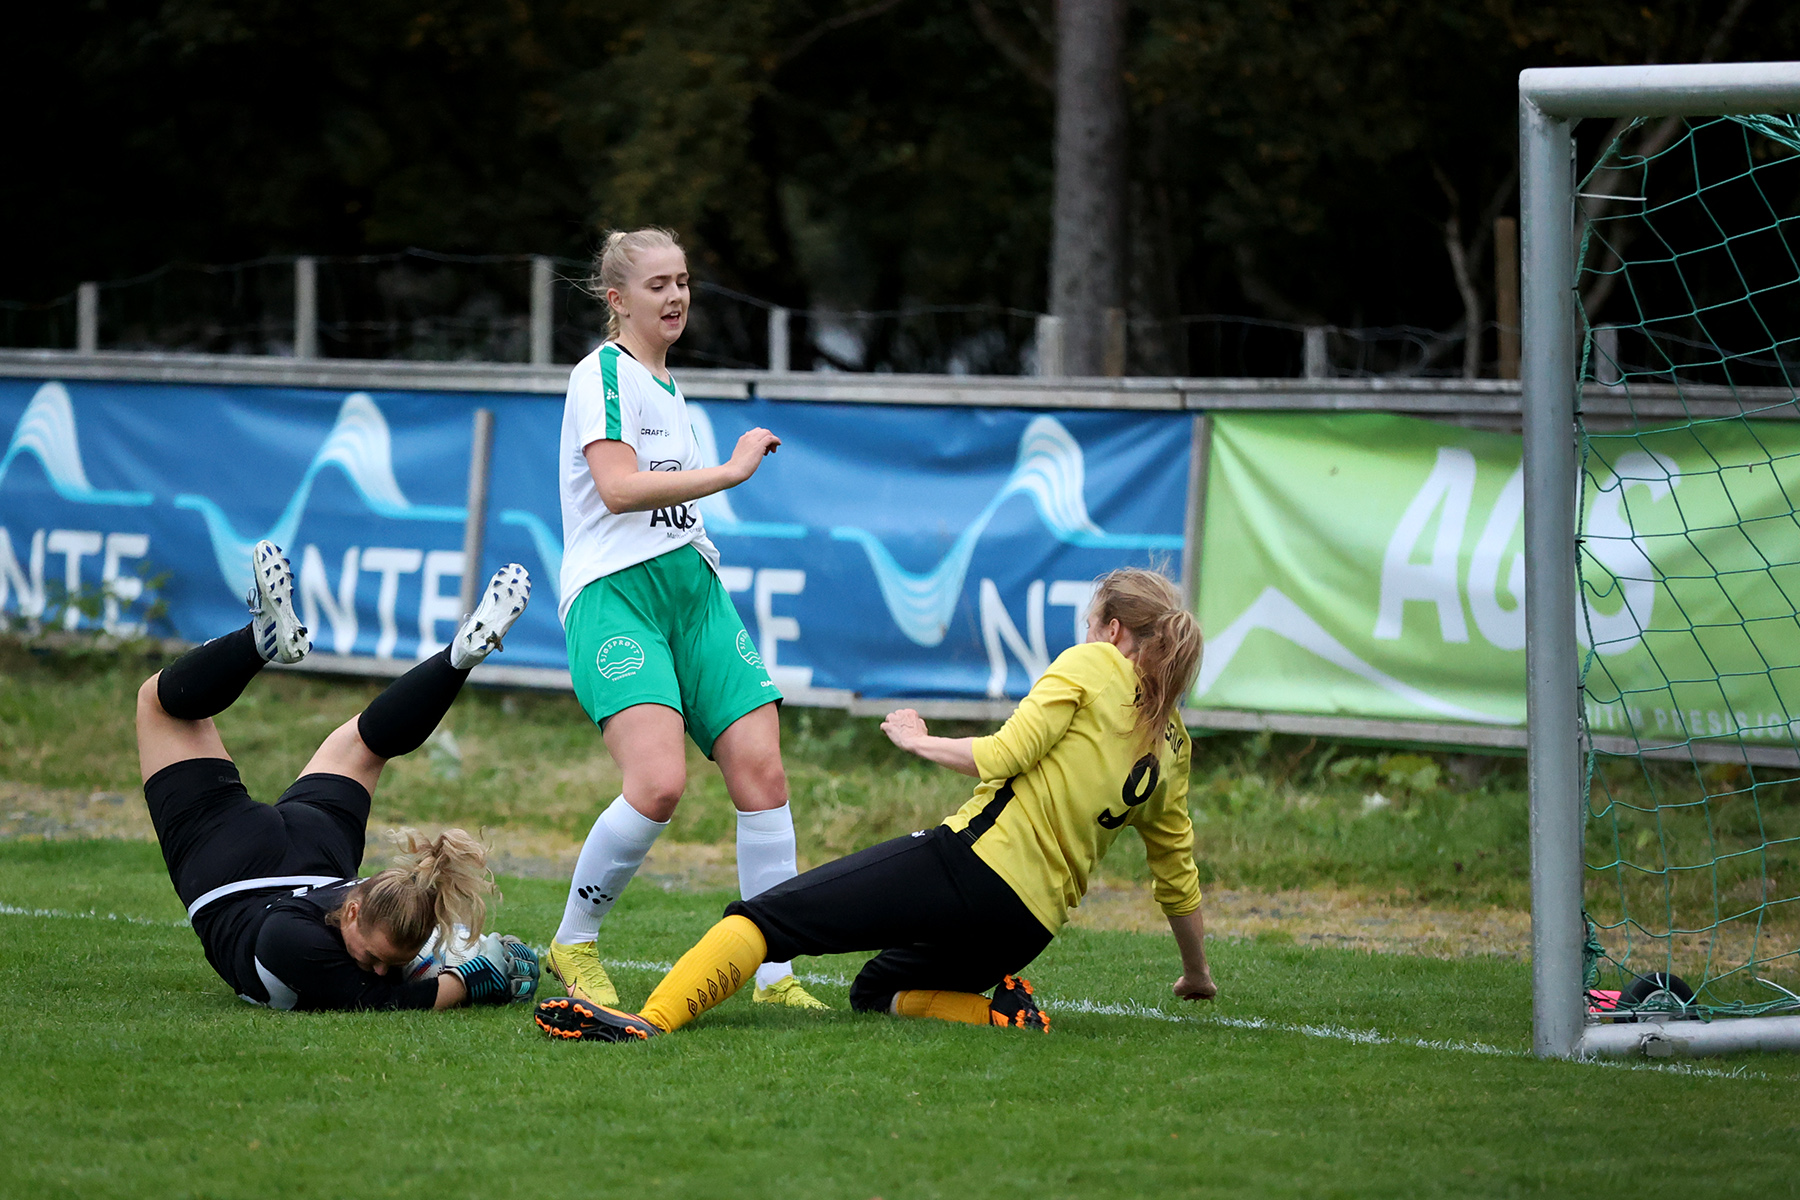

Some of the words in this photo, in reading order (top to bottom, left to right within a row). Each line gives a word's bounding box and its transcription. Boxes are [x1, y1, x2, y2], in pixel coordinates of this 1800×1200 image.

[640, 428, 664, 437] CRAFT
[0, 526, 150, 637] NTE
[299, 544, 468, 659] NTE
[600, 640, 640, 663] SJØSPRØYT
[979, 577, 1187, 698] NT
[1097, 753, 1161, 830] 9
